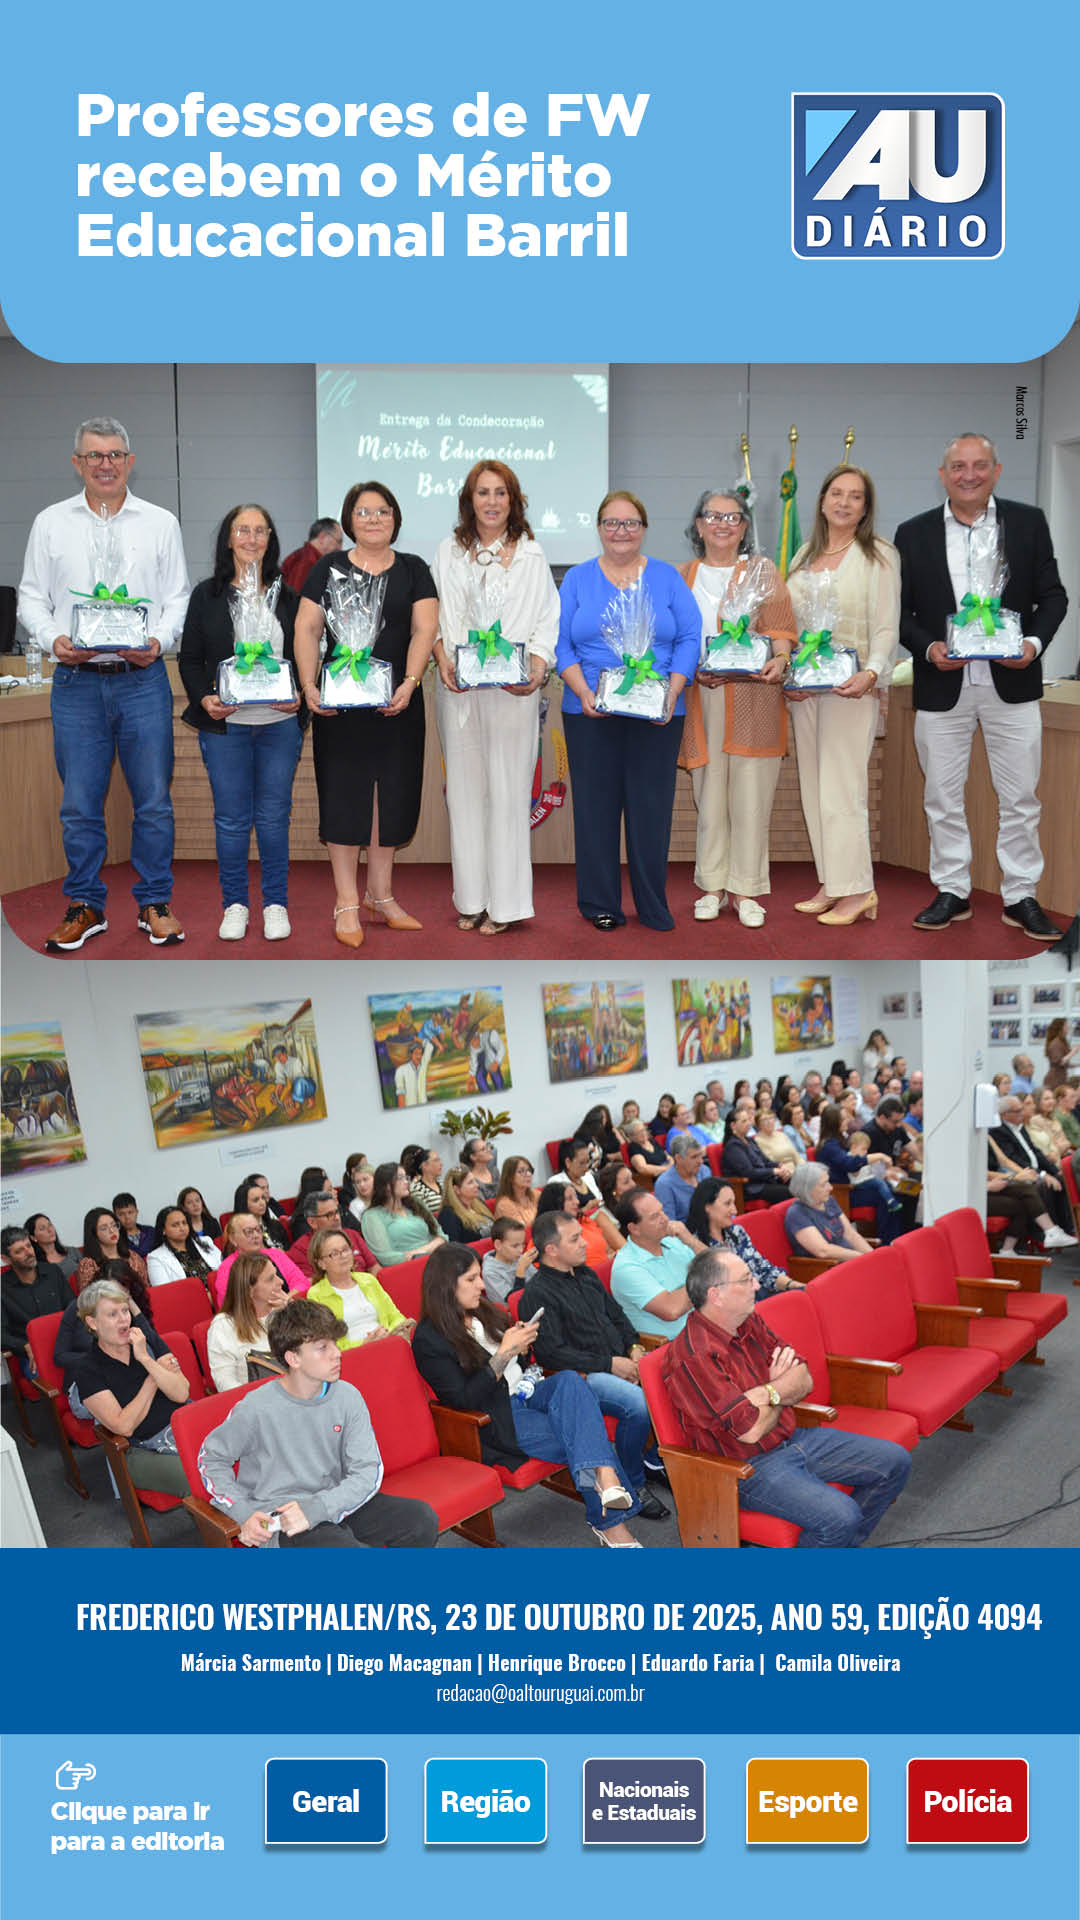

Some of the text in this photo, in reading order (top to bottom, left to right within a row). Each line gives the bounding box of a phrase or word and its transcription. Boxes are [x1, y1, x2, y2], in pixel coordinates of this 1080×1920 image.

[380, 412, 545, 430] Entrega da Condecoração
[358, 434, 557, 462] Mérito Educacional
